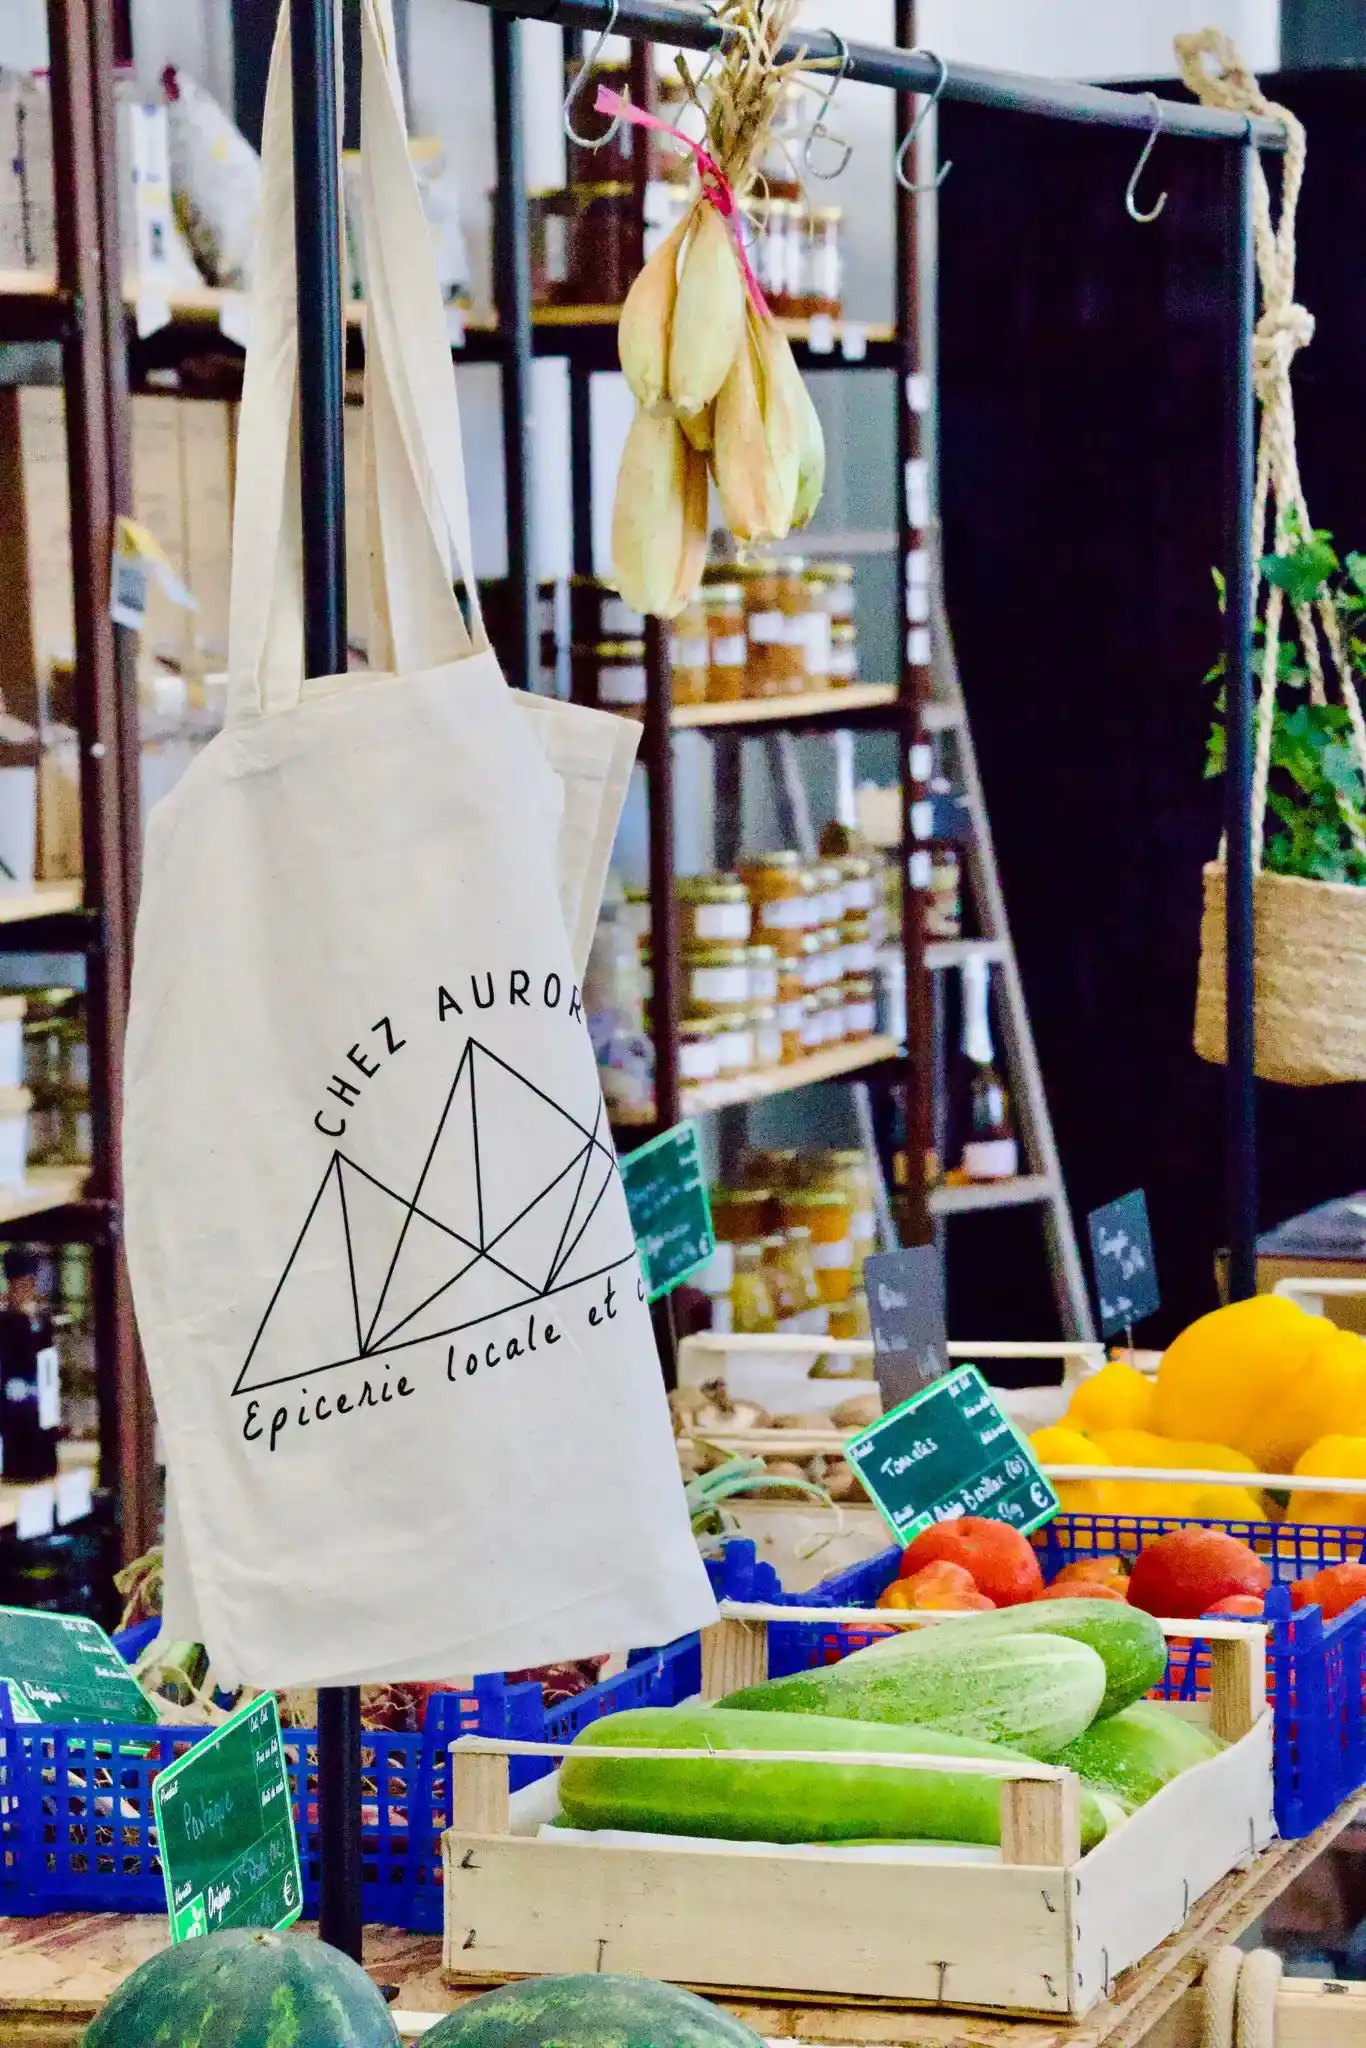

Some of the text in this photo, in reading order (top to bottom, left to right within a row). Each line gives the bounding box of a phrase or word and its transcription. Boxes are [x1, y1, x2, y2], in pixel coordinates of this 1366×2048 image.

[314, 1016, 407, 1138] CHEZ
[243, 1364, 416, 1451] Epicerie
[446, 1314, 561, 1382] locale
[588, 1276, 618, 1325] et
[208, 1880, 232, 1923] Origine
[283, 1871, 296, 1907] €
